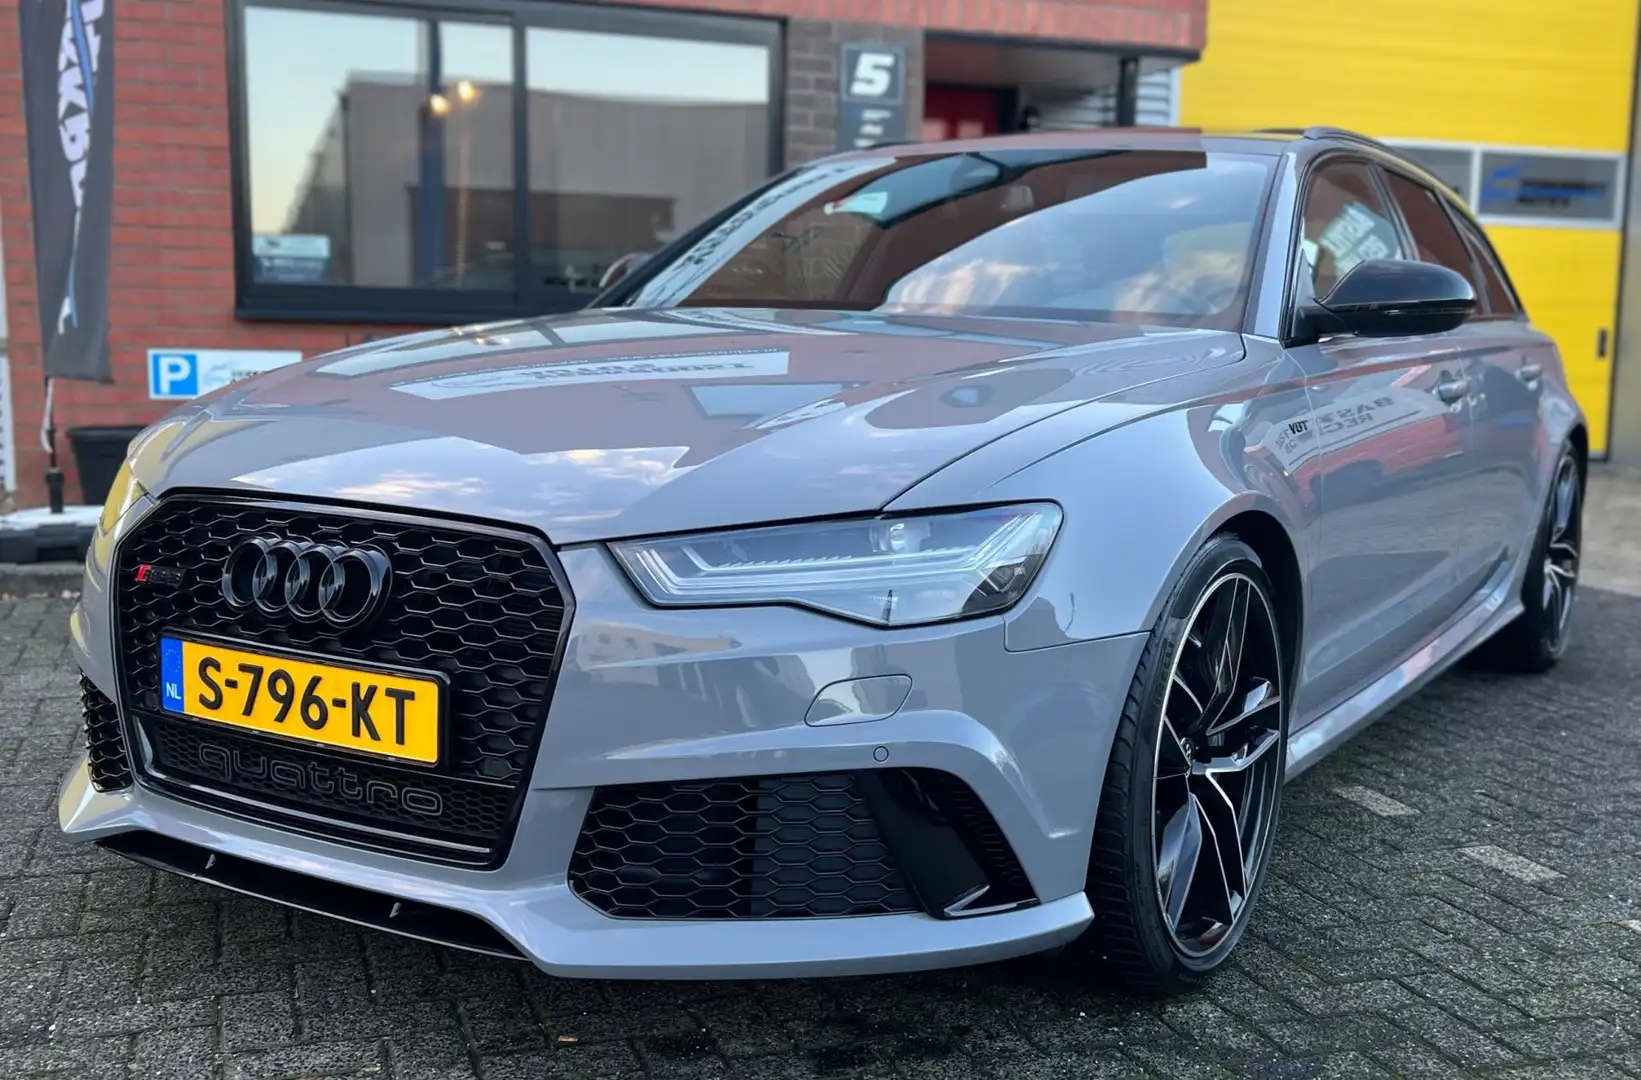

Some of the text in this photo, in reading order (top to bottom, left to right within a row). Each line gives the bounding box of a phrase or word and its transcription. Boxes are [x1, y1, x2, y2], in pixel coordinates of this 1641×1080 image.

[850, 52, 893, 96] 5
[159, 357, 191, 393] P
[165, 681, 182, 700] NL
[197, 656, 416, 746] S-796-KT
[197, 744, 442, 816] quattro
